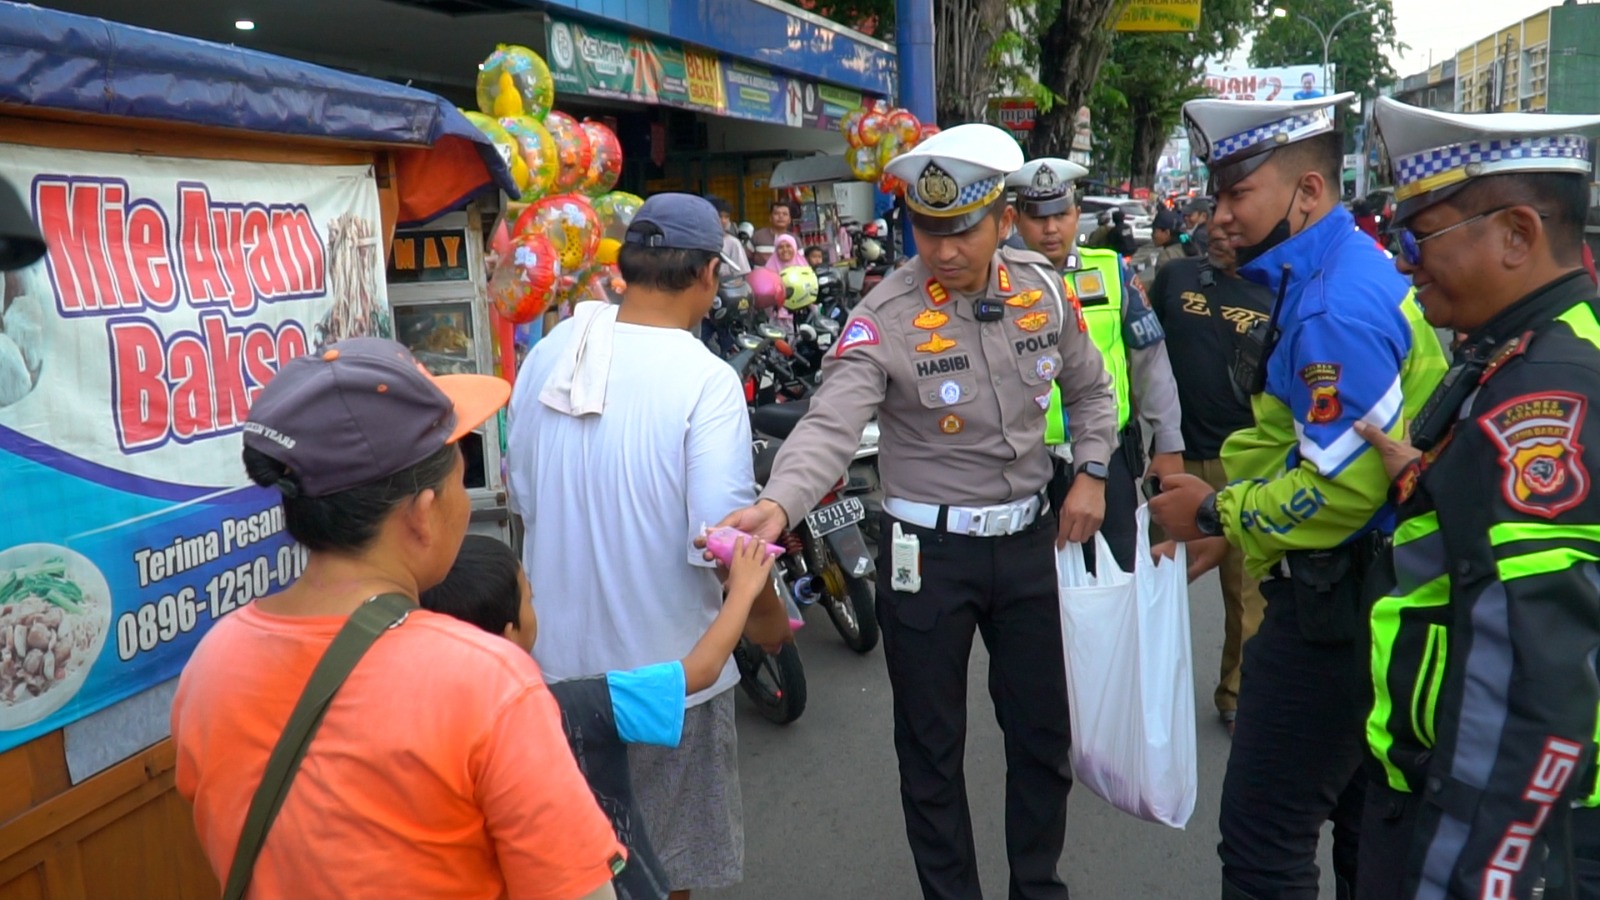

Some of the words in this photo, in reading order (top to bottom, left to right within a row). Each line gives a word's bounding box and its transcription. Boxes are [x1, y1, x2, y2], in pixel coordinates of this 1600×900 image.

[32, 175, 177, 317] Mie
[177, 181, 326, 316] Ayam
[1015, 331, 1059, 355] POLRI
[916, 355, 970, 377] HABIBI
[1506, 400, 1560, 417] POLRES
[817, 504, 843, 524] 6711
[833, 516, 846, 527] 07
[134, 530, 219, 587] Terima
[1482, 735, 1584, 900] POLISI
